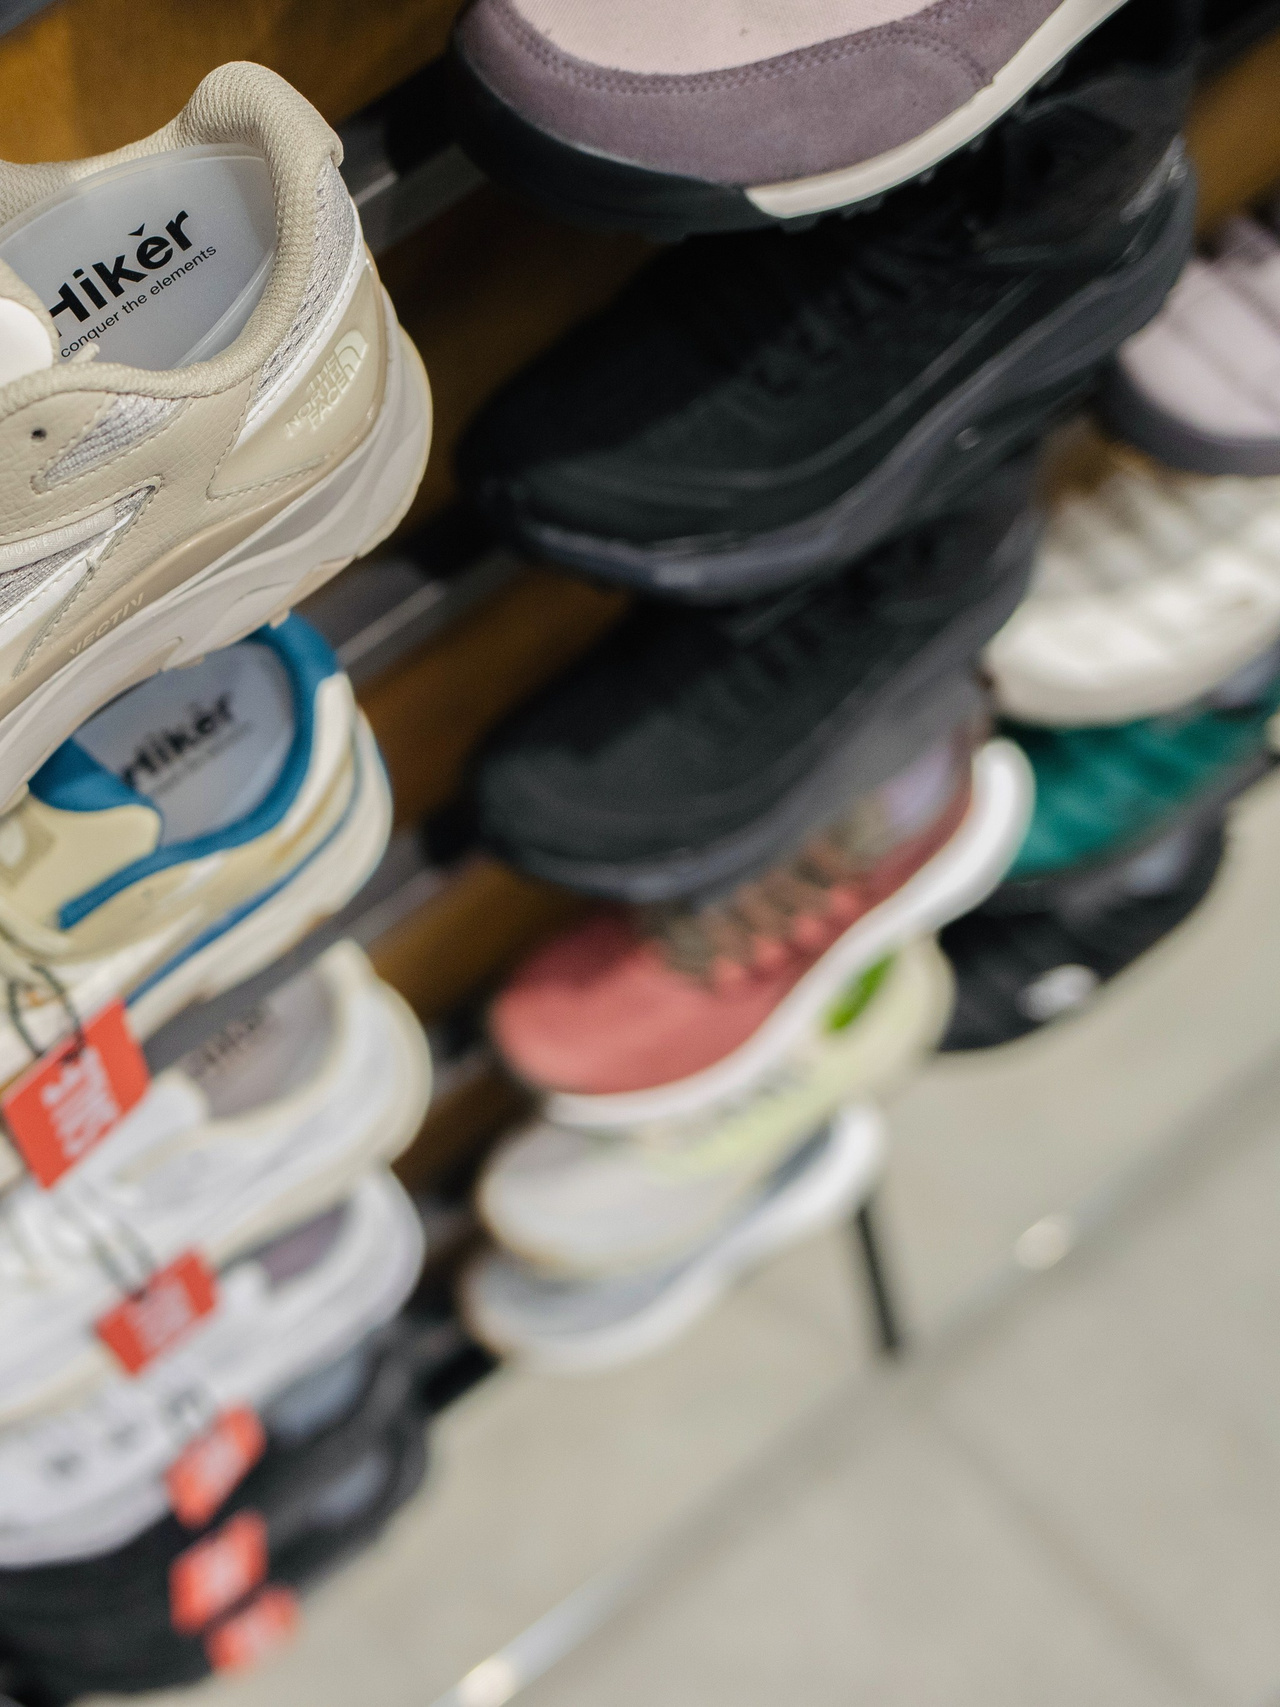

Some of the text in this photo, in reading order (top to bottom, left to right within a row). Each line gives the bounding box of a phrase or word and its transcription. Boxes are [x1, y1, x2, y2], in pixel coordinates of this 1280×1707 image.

[60, 245, 217, 358] conquer the elements
[285, 361, 343, 437] NORTH
[306, 354, 338, 393] THE
[307, 373, 351, 431] FACE
